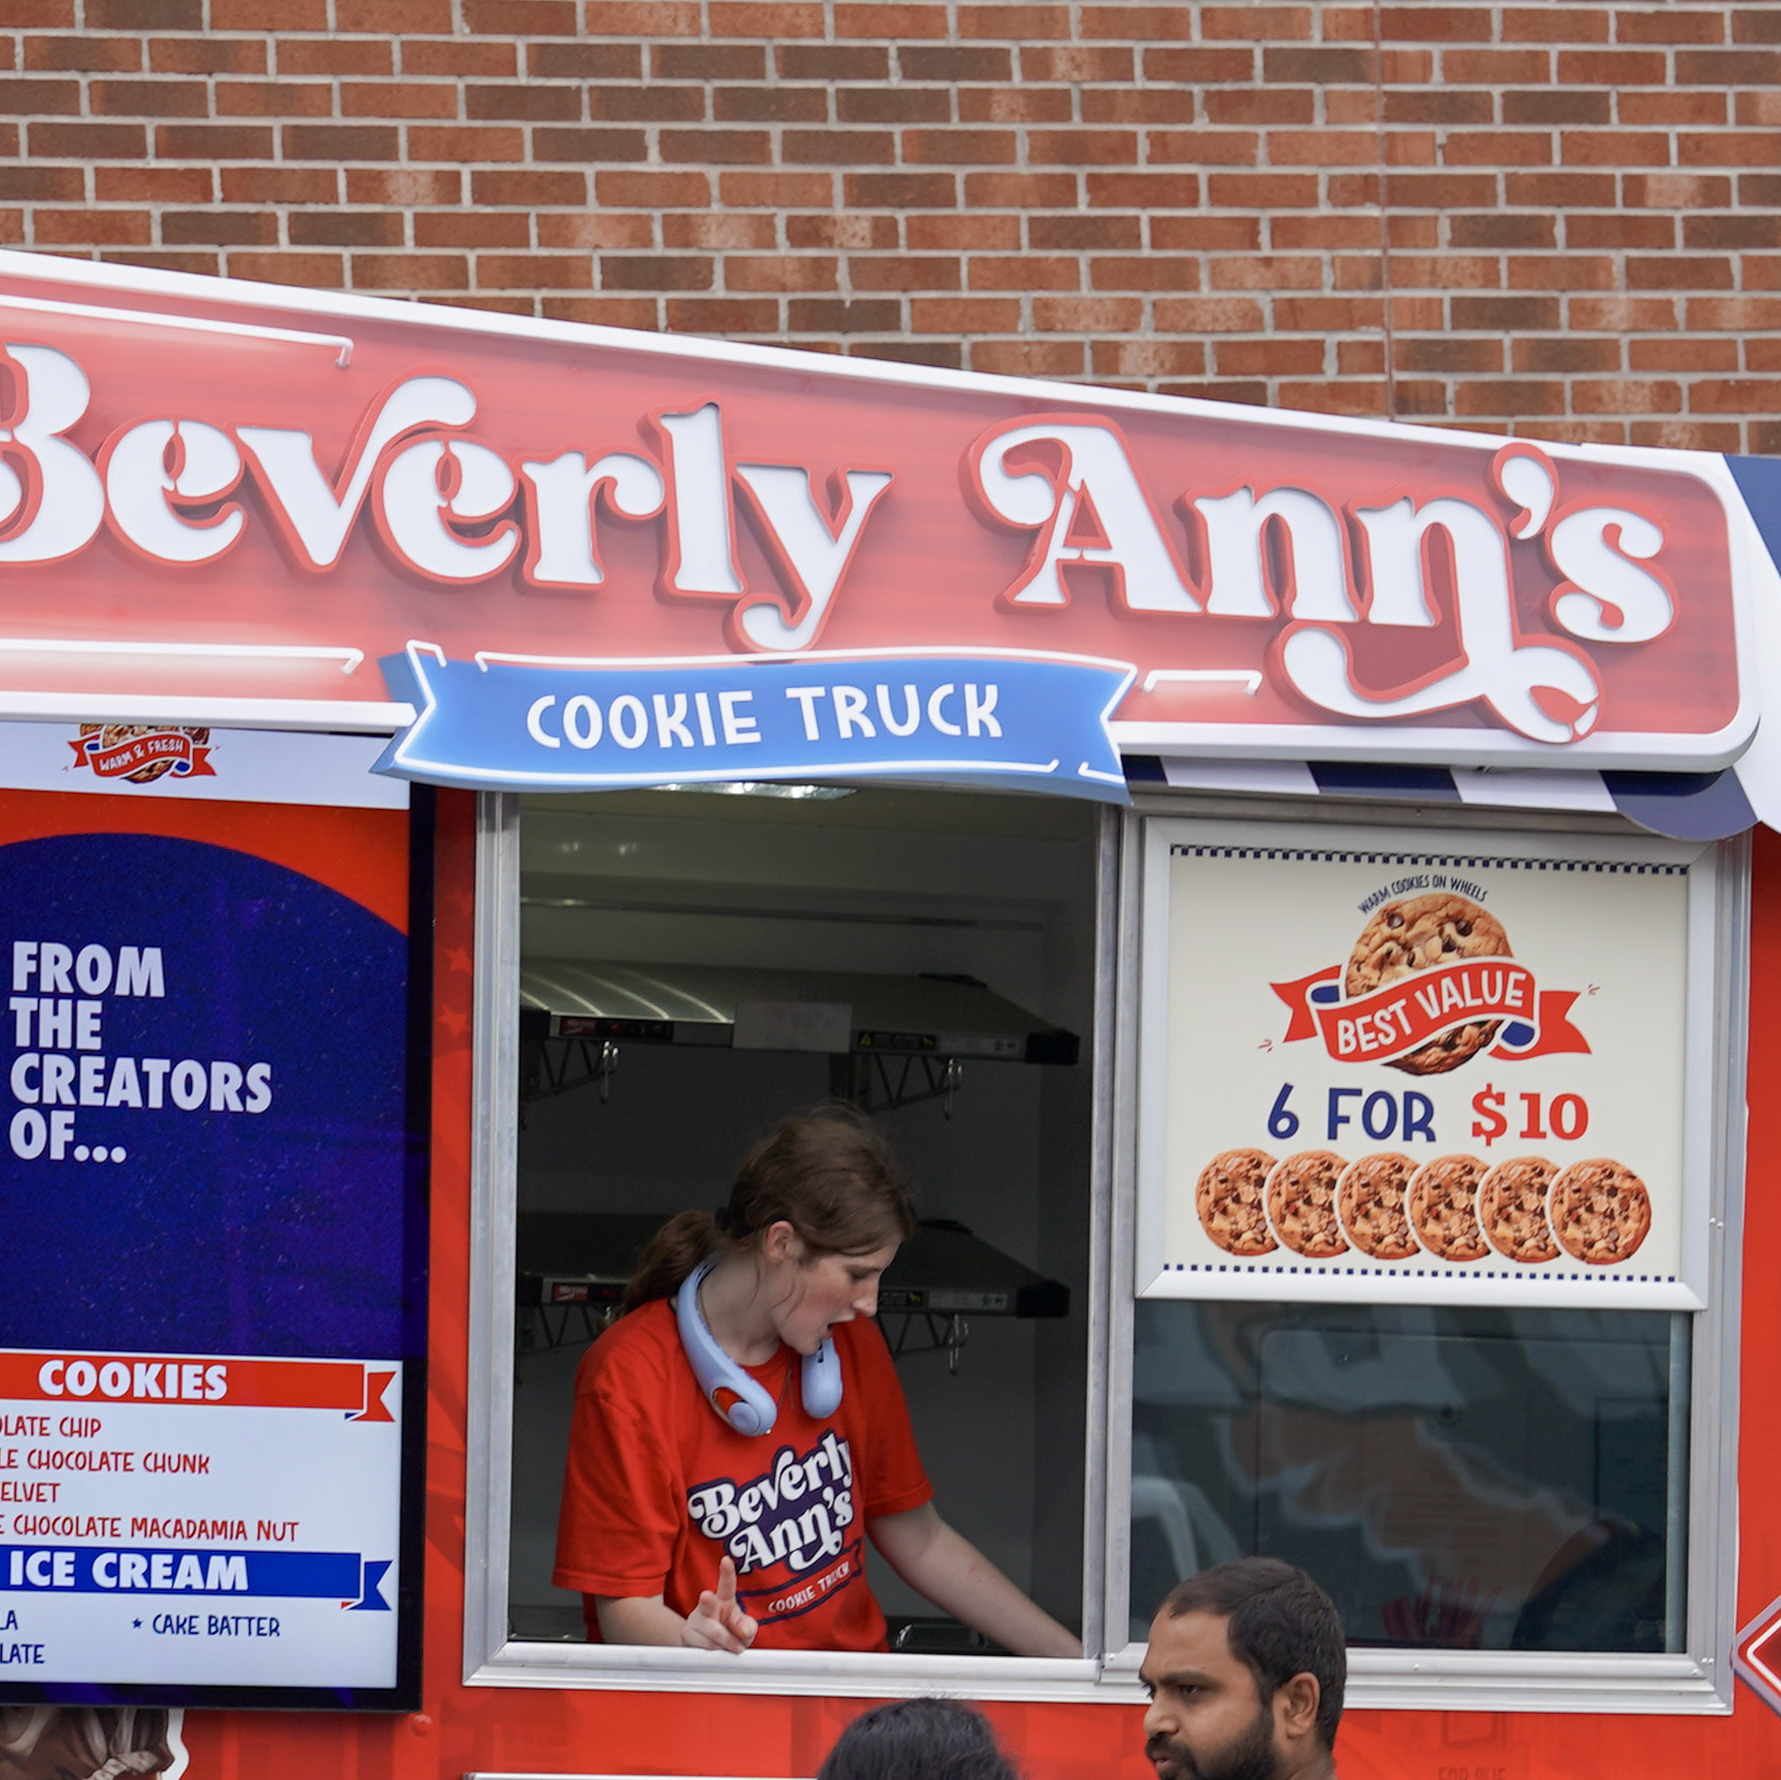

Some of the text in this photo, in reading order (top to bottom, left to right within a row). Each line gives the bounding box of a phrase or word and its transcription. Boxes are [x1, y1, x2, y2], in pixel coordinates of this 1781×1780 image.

[980, 415, 1676, 740] Ann's
[526, 674, 1002, 750] COOKIE TRUCK
[99, 739, 184, 772] WARM & FRESH
[1358, 875, 1488, 915] WARM COOKIES ON WHEELS
[13, 941, 165, 998] FROM
[10, 997, 103, 1050] THE
[1336, 971, 1527, 1056] BEST VALUE
[10, 1052, 272, 1113] CREATORS
[9, 1108, 127, 1163] OF...
[1267, 1083, 1589, 1146] 6 FOR $10
[38, 1360, 228, 1401] COOKIES
[60, 1416, 101, 1439] CHIP
[27, 1448, 135, 1473] CHOCOLATE
[143, 1452, 210, 1475] CHUNK
[688, 1432, 853, 1538] Beverly
[13, 1514, 122, 1538] CHOCOLATE
[130, 1517, 248, 1542] MACADAMIA
[256, 1520, 299, 1543] NUT
[729, 1486, 854, 1575] Ann's
[9, 1550, 249, 1592] ICE CREAM
[768, 1561, 851, 1614] COOKIE TRUCK
[152, 1614, 280, 1638] CAKE BATTER
